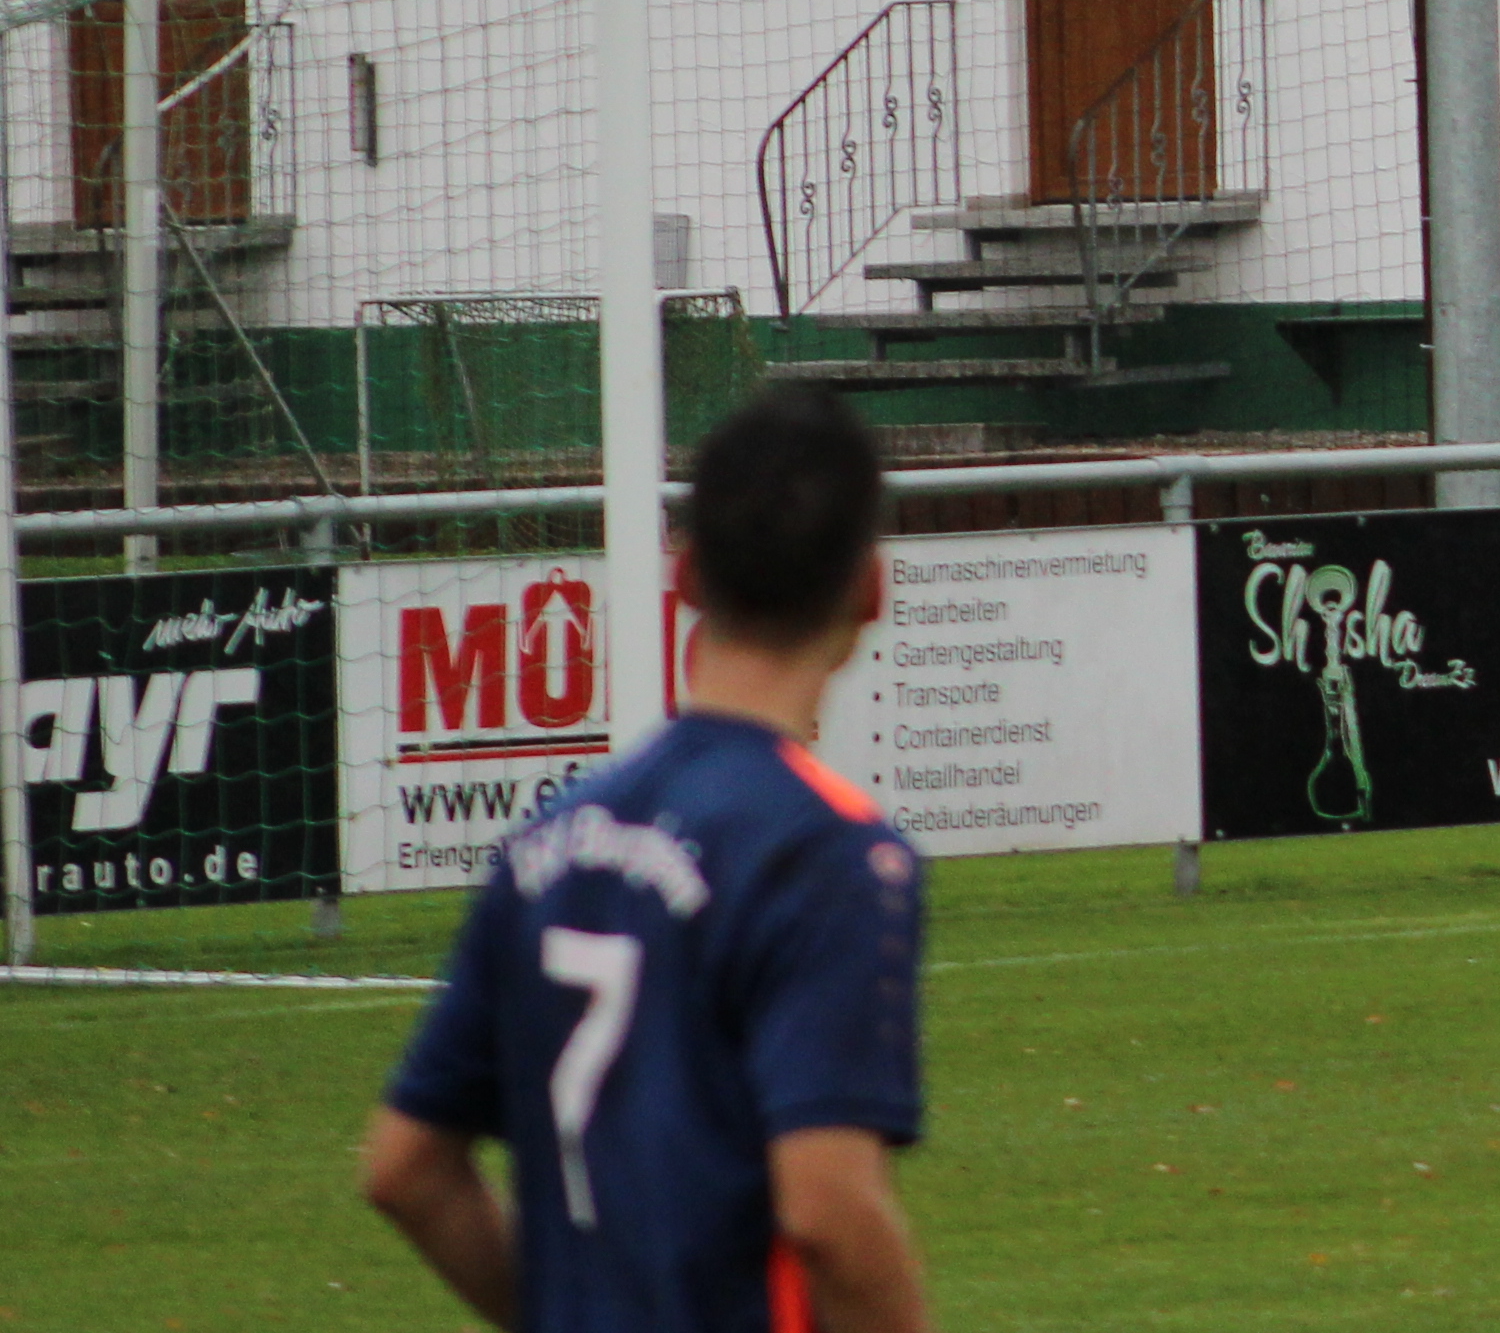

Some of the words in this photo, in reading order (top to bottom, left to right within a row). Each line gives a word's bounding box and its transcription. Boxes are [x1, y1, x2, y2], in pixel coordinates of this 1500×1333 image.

[893, 551, 1147, 584] Baumaschinenvermietung
[893, 599, 1007, 626] Erdarbeiten
[1245, 559, 1426, 673] Shisha
[893, 636, 1064, 670] Gartengestaltung
[893, 681, 1000, 708] Transporte
[22, 666, 262, 833] ayr
[893, 718, 1053, 750] Containerdienst
[893, 760, 1021, 791] Metallhandel
[893, 800, 1102, 833] Gebäuderäumungen
[37, 844, 259, 893] rauto.de
[541, 926, 643, 1229] 7
